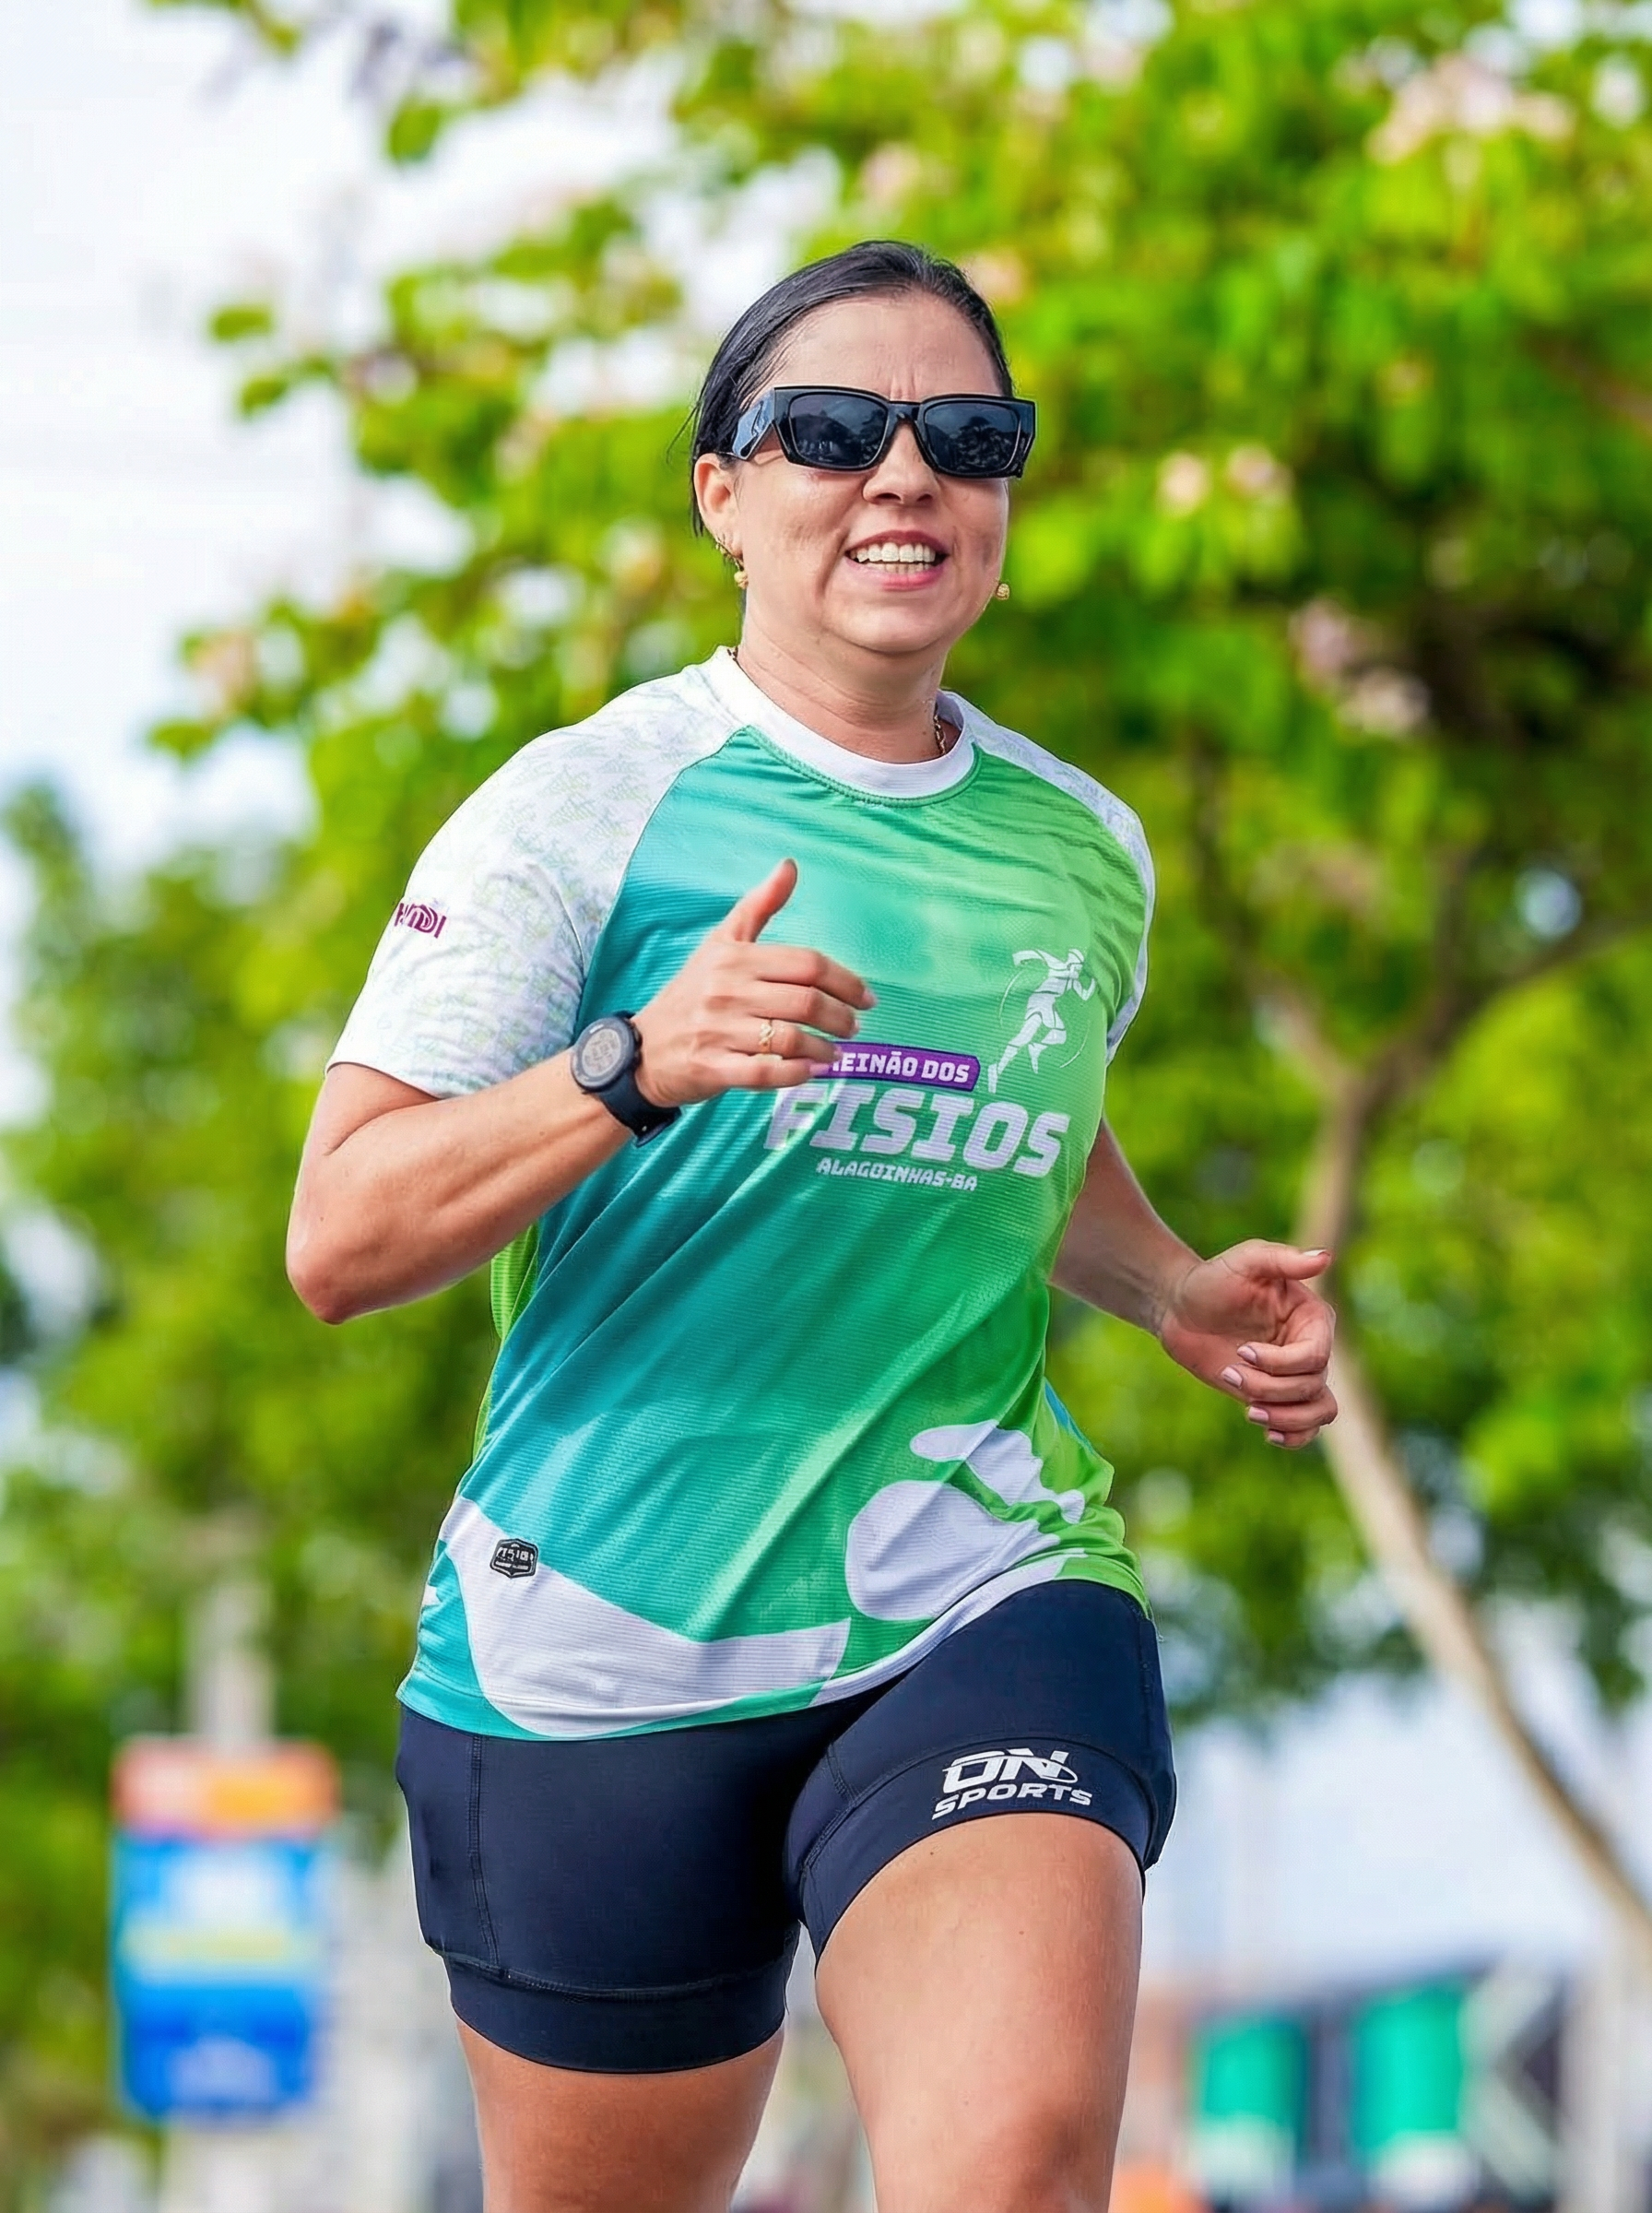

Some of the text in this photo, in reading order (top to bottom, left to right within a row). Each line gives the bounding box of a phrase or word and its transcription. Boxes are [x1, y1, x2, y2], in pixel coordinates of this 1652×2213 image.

[921, 1059, 971, 1083] DOS
[763, 1085, 1070, 1178] FISIOS
[816, 1157, 977, 1191] ALAGOINHAS-BA
[942, 1748, 1078, 1793] ON
[932, 1783, 1092, 1820] SPORTS
